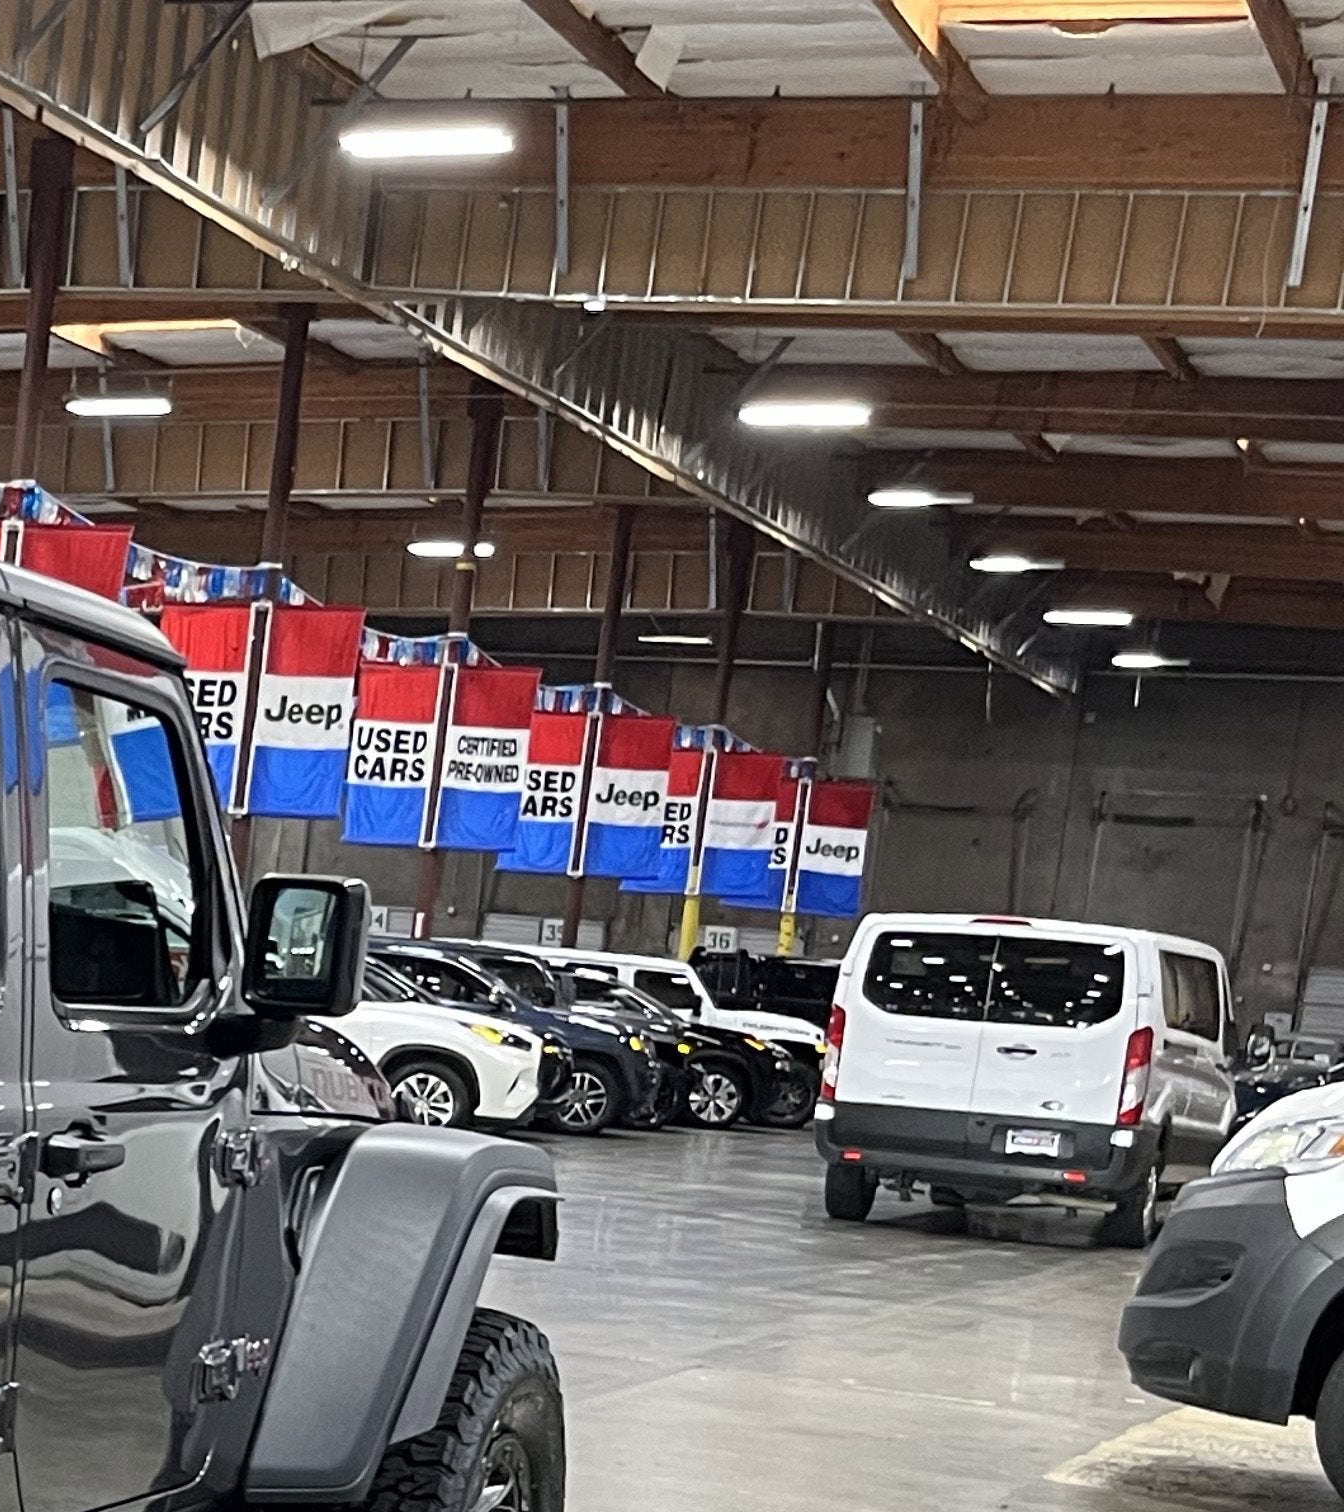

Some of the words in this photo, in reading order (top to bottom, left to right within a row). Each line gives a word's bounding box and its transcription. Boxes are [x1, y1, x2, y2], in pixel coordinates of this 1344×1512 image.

[185, 677, 237, 707] SED
[264, 695, 344, 731] Jeep
[194, 711, 233, 740] RS
[356, 726, 428, 755] USED
[457, 735, 518, 758] CERTIFIED
[353, 754, 425, 782] CARS
[446, 760, 520, 784] PRE-OWNED
[526, 769, 576, 793] SED
[520, 795, 573, 818] ARS
[595, 783, 660, 812] Jeep
[663, 802, 692, 822] ED
[660, 824, 689, 844] RS
[805, 838, 860, 863] Jeep
[706, 932, 731, 950] 36
